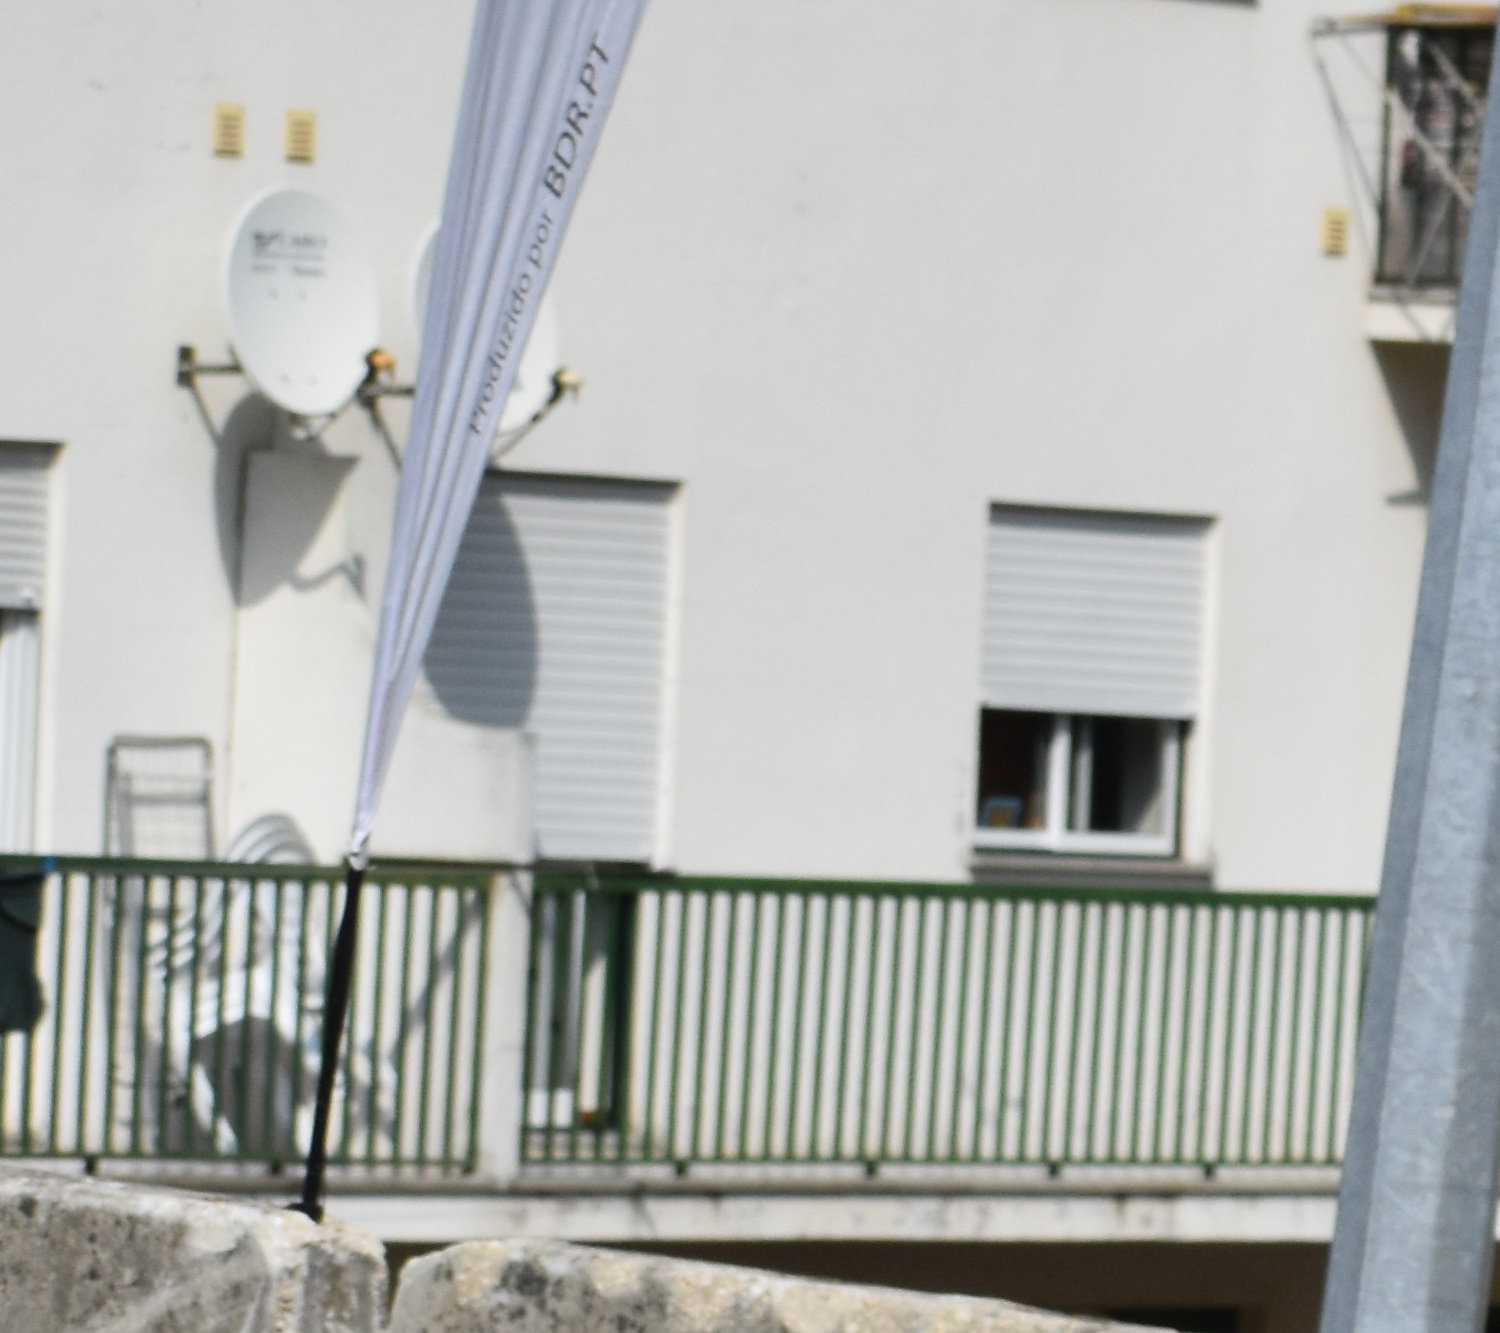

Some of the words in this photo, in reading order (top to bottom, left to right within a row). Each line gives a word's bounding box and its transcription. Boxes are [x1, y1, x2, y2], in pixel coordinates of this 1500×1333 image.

[467, 271, 532, 437] Produzido
[528, 212, 556, 269] por
[543, 33, 611, 201] BDR.PT
